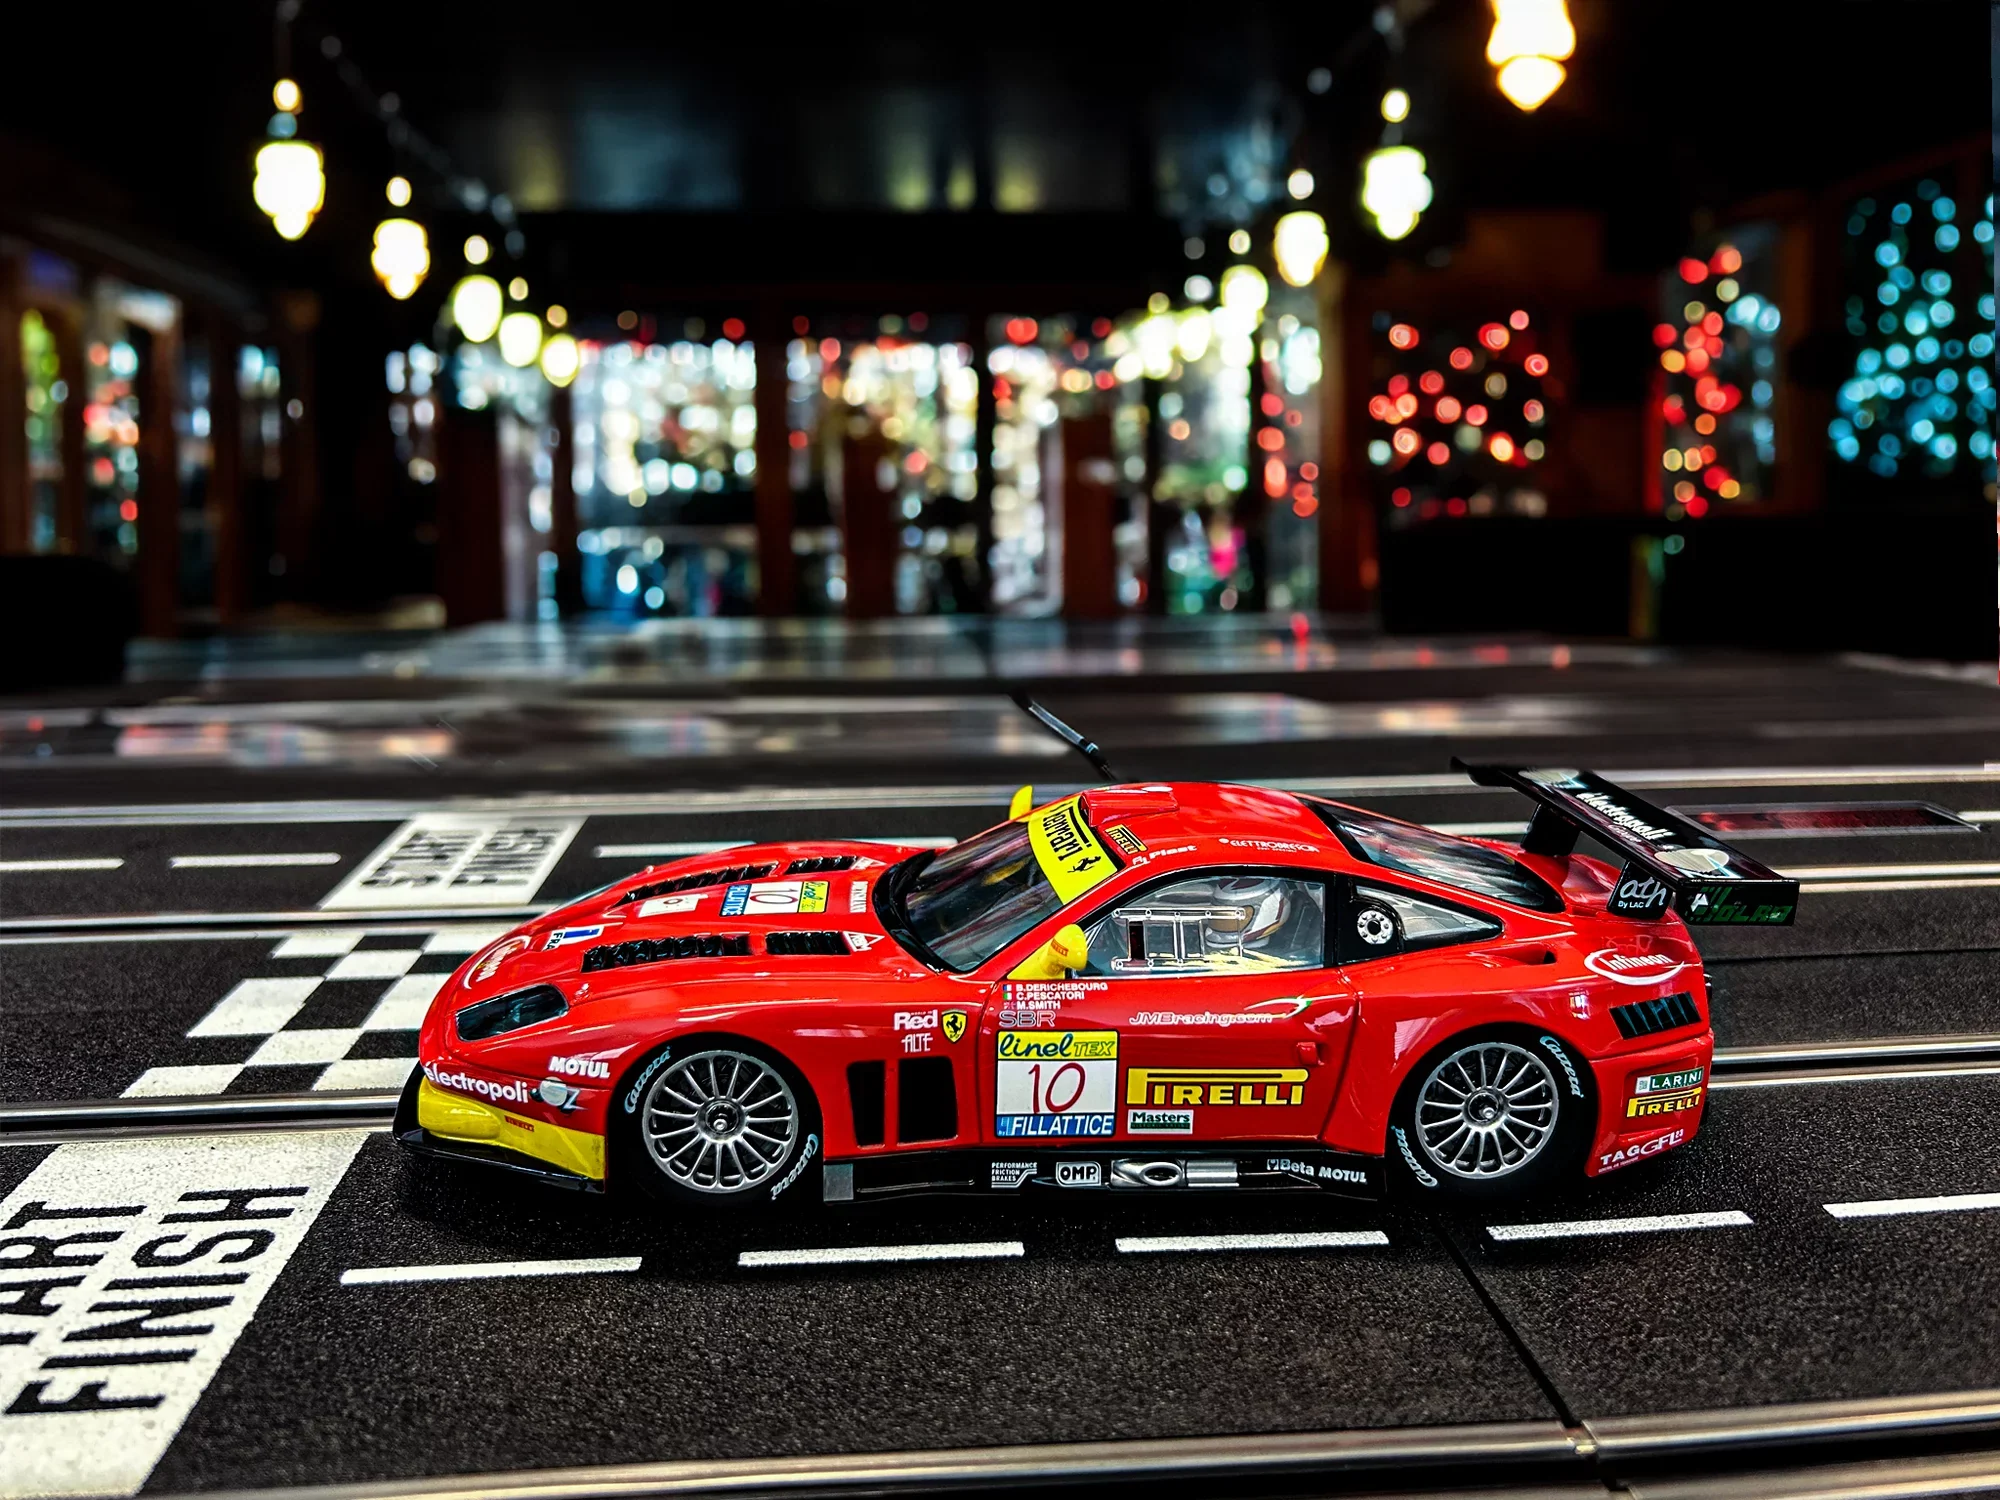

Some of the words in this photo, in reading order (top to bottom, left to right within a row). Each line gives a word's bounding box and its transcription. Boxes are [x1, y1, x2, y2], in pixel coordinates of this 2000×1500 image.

[1043, 801, 1092, 861] Ferrari
[1105, 824, 1147, 854] PIRELLI
[749, 888, 799, 905] 10
[1617, 900, 1628, 909] By
[1629, 901, 1644, 909] LAC
[546, 932, 564, 950] FRA
[1598, 954, 1675, 971] Infineon
[1015, 982, 1109, 992] B.DERICHEBOURG
[1015, 991, 1085, 1000] C.PESCATORI
[1016, 1000, 1061, 1010] M.SMITH
[893, 1009, 938, 1031] Red
[998, 1010, 1057, 1028] SBR
[1129, 1011, 1273, 1027] JMBracing.com
[548, 1056, 610, 1079] MOTUL
[1540, 1036, 1585, 1098] Carrera
[424, 1060, 528, 1103] électropoli
[624, 1046, 672, 1114] Carrera
[1028, 1062, 1086, 1113] 10
[1126, 1067, 1309, 1105] PIRELLI
[1651, 1070, 1703, 1089] LARINI
[1626, 1086, 1702, 1118] PIRELLI
[1012, 1115, 1115, 1136] FILLATTICE
[1132, 1111, 1191, 1122] Masters
[1390, 1125, 1439, 1188] Carrera
[1600, 1145, 1641, 1166] TAG
[770, 1133, 819, 1200] Carrera
[1059, 1165, 1097, 1181] OMP
[1280, 1158, 1315, 1177] Beta
[1318, 1166, 1368, 1184] MOTUL
[4, 1187, 310, 1415] FINISH
